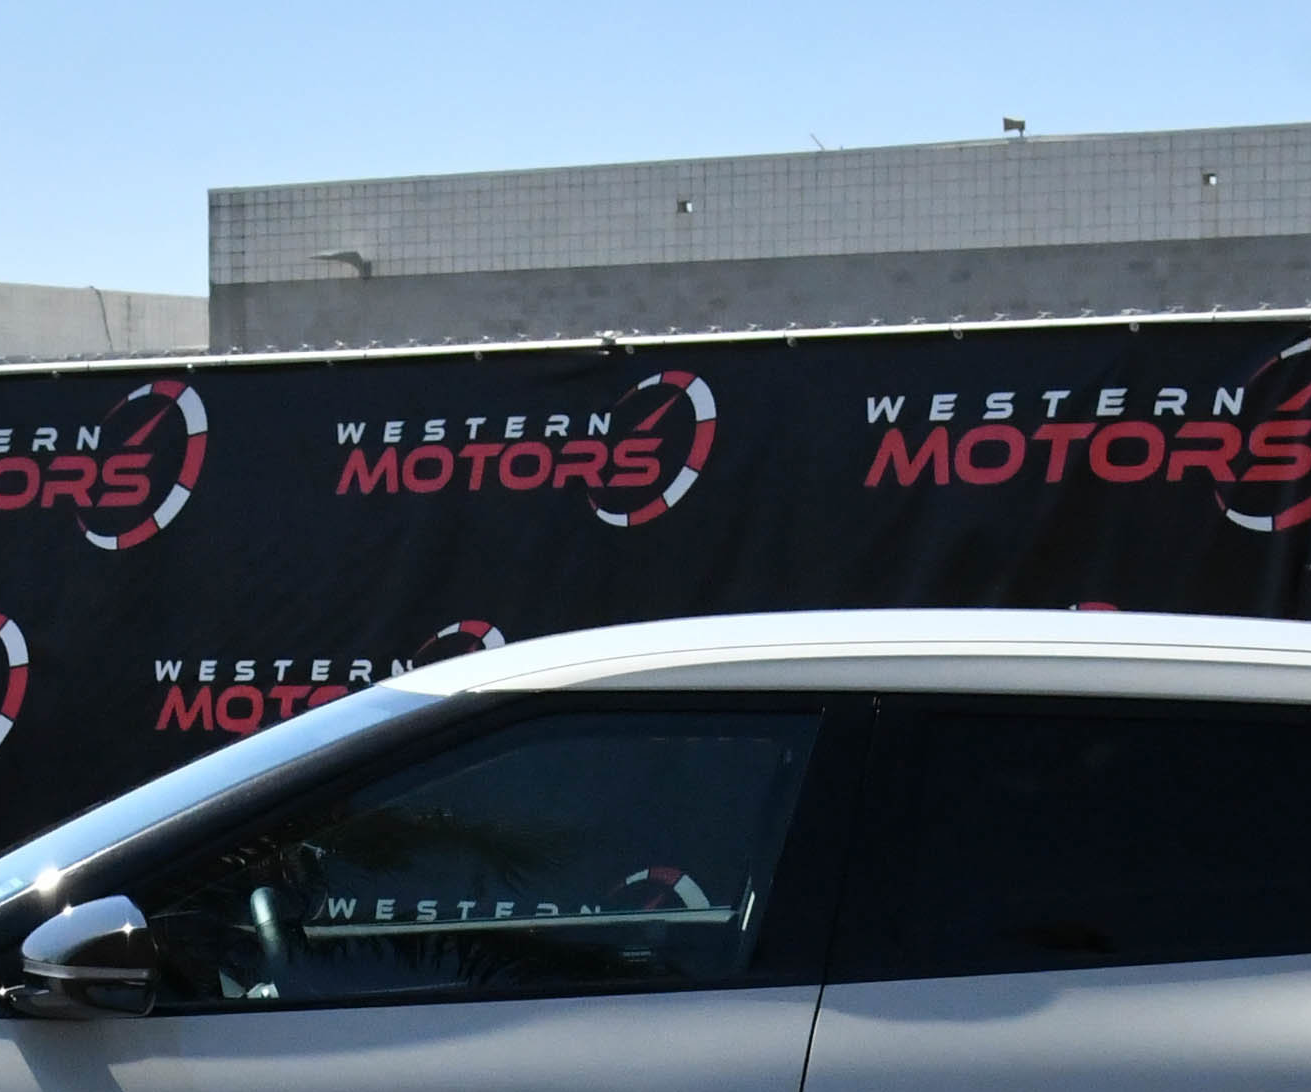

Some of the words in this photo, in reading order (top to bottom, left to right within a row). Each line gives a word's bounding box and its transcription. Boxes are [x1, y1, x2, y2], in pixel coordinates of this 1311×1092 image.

[868, 388, 1244, 423] WESTERN
[338, 413, 610, 444] WESTERN
[338, 438, 662, 494] MOTORS
